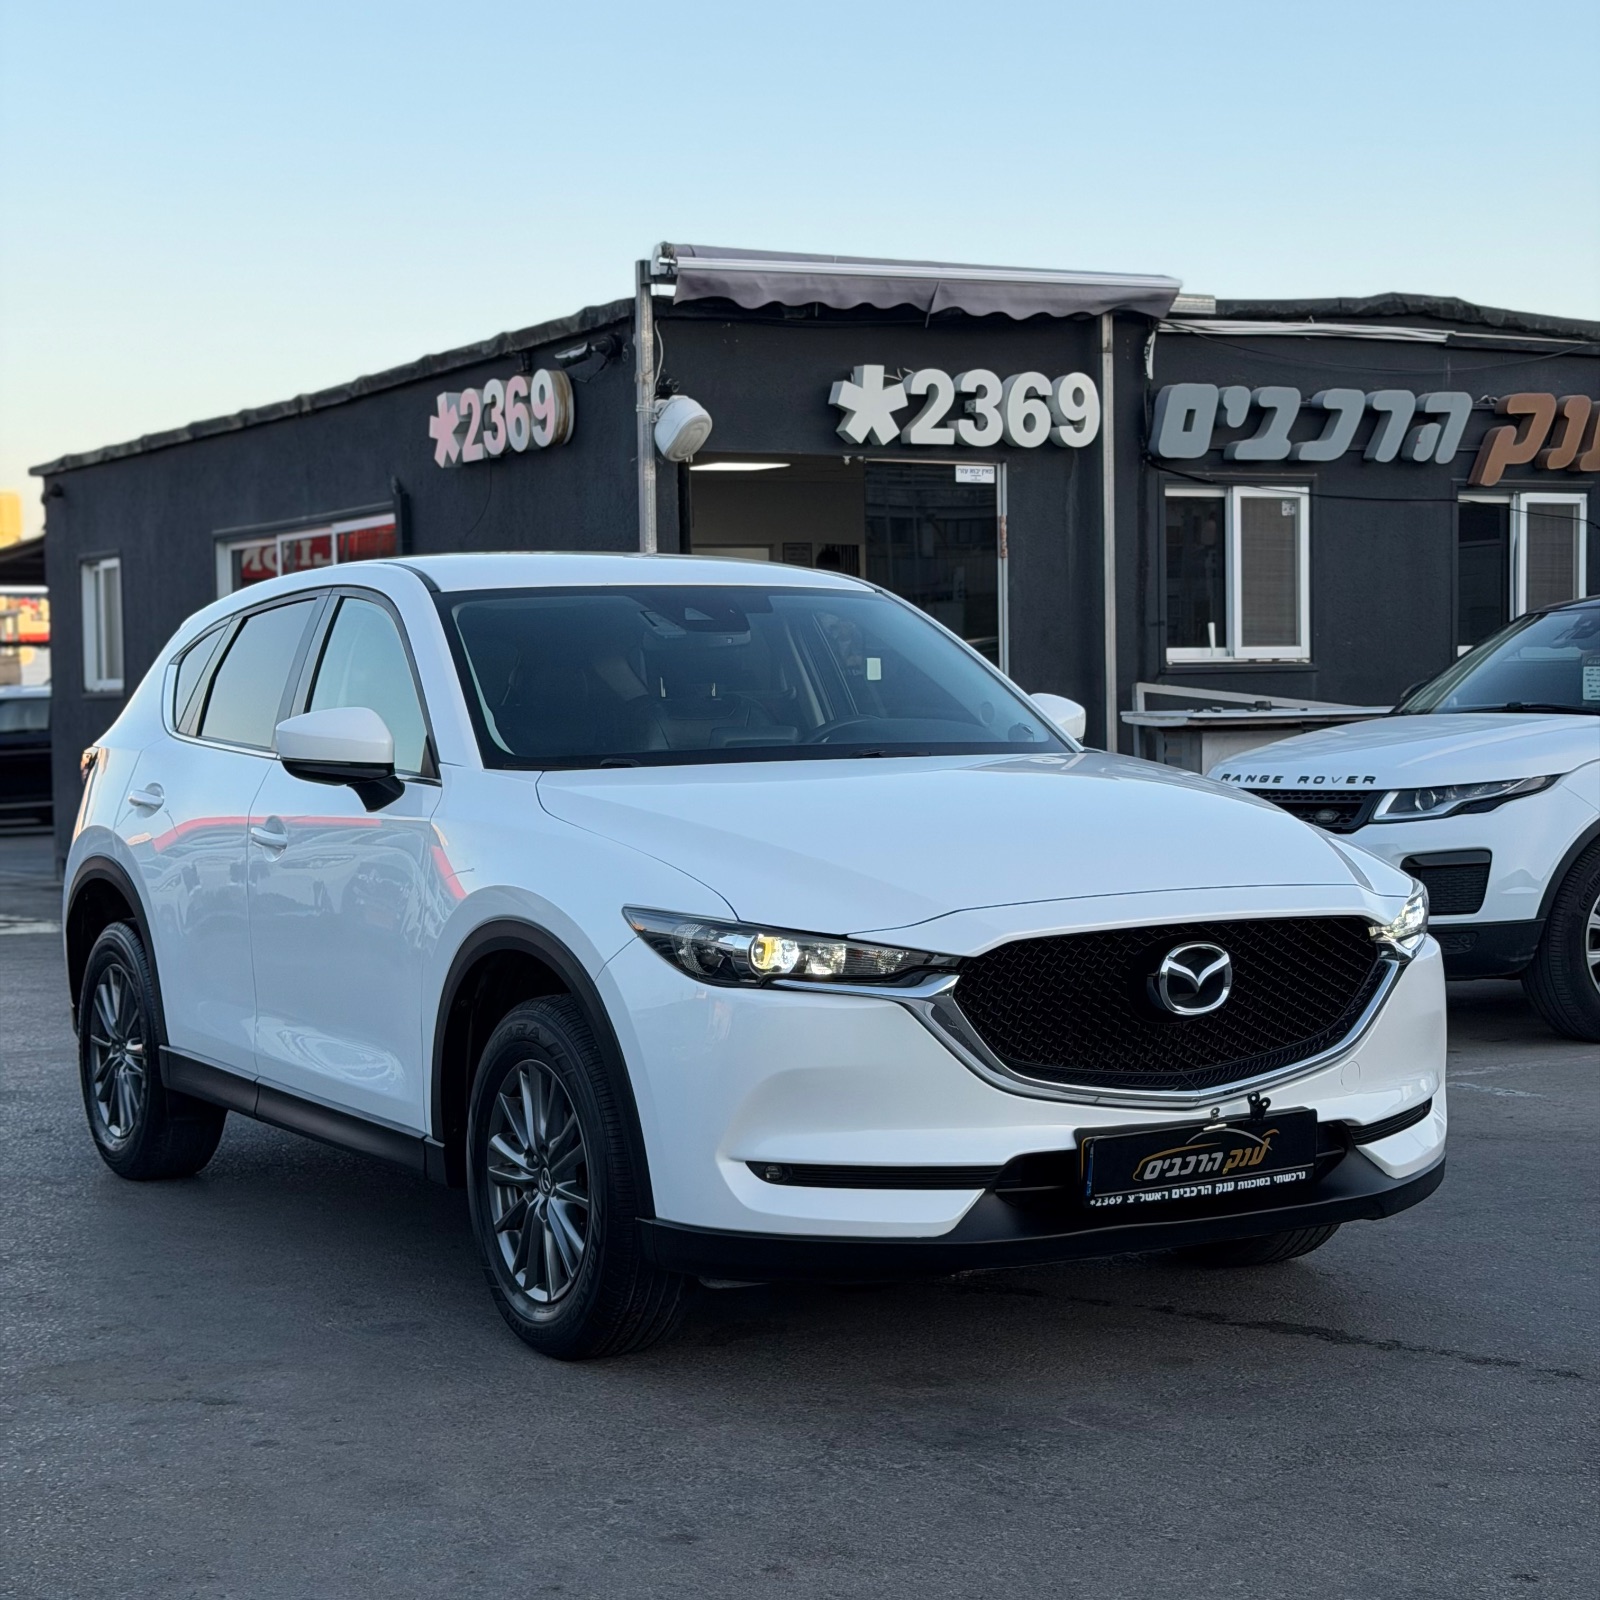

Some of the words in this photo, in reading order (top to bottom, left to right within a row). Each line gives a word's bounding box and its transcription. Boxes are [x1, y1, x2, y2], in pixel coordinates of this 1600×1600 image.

[1154, 384, 1472, 463] הרכבים
[1469, 392, 1600, 487] נק
[1220, 773, 1284, 784] RANGE
[1297, 775, 1377, 785] ROVER
[1143, 1151, 1224, 1180] הרכבים
[1222, 1136, 1271, 1175] ענק
[1171, 1185, 1212, 1199] הרכבים
[1215, 1181, 1235, 1195] ענק
[1237, 1176, 1271, 1190] בסוכנות
